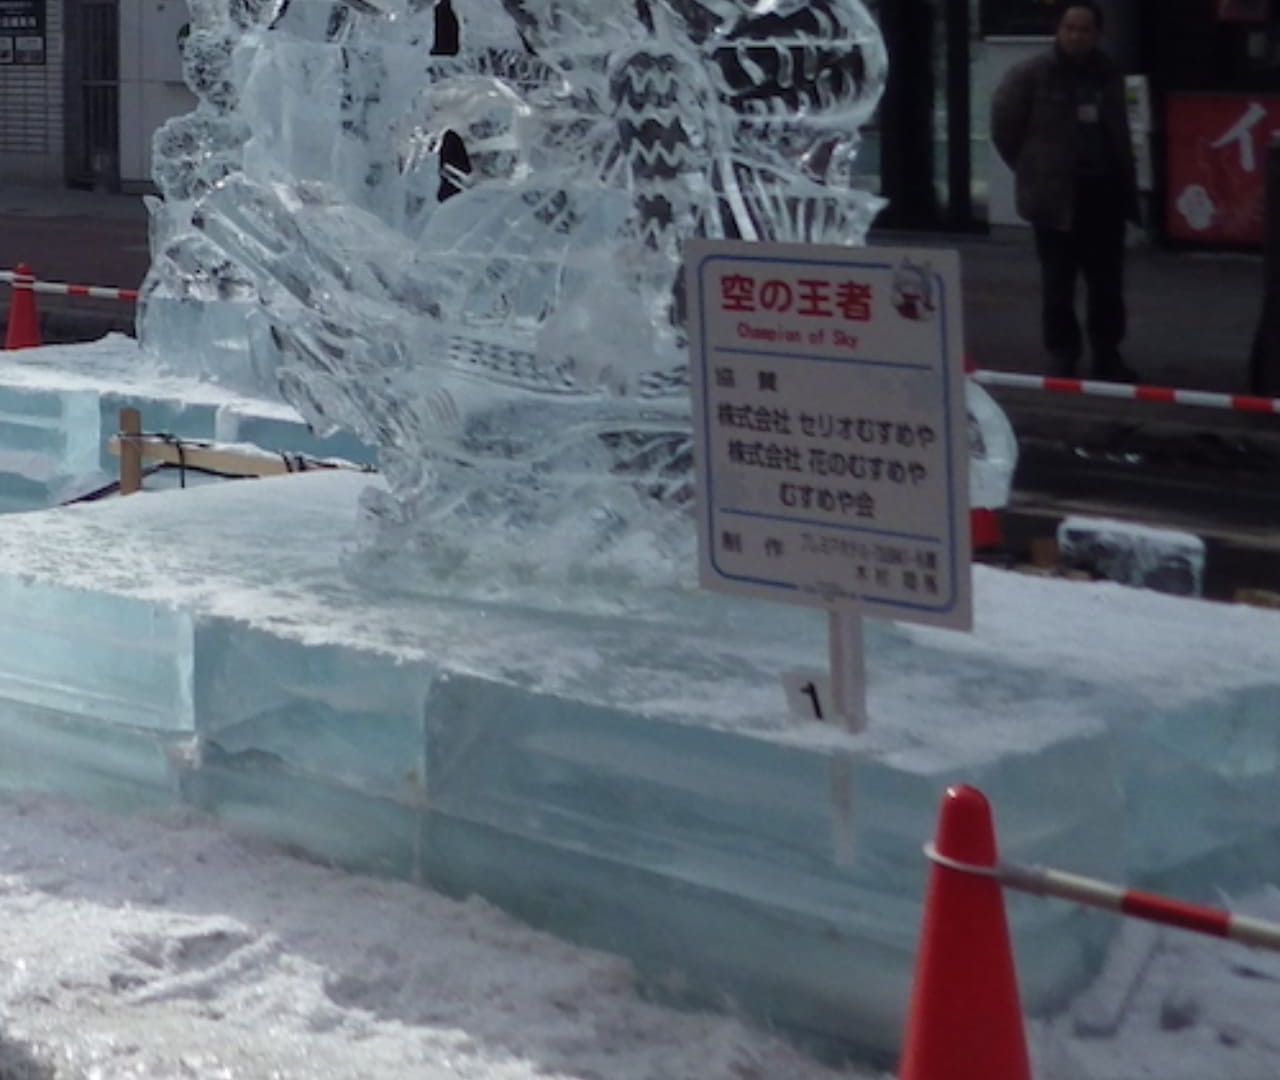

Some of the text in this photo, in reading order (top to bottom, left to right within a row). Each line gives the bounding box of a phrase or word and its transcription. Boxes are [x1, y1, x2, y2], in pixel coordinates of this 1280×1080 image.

[719, 273, 873, 323] 空の王者
[737, 323, 803, 345] Champion
[809, 330, 826, 346] of
[716, 403, 936, 450] 株式会社 セリオむすめや
[727, 440, 927, 486] 株式会社 花のむすめや
[779, 482, 876, 519] むすめや会
[800, 681, 824, 720] 1
